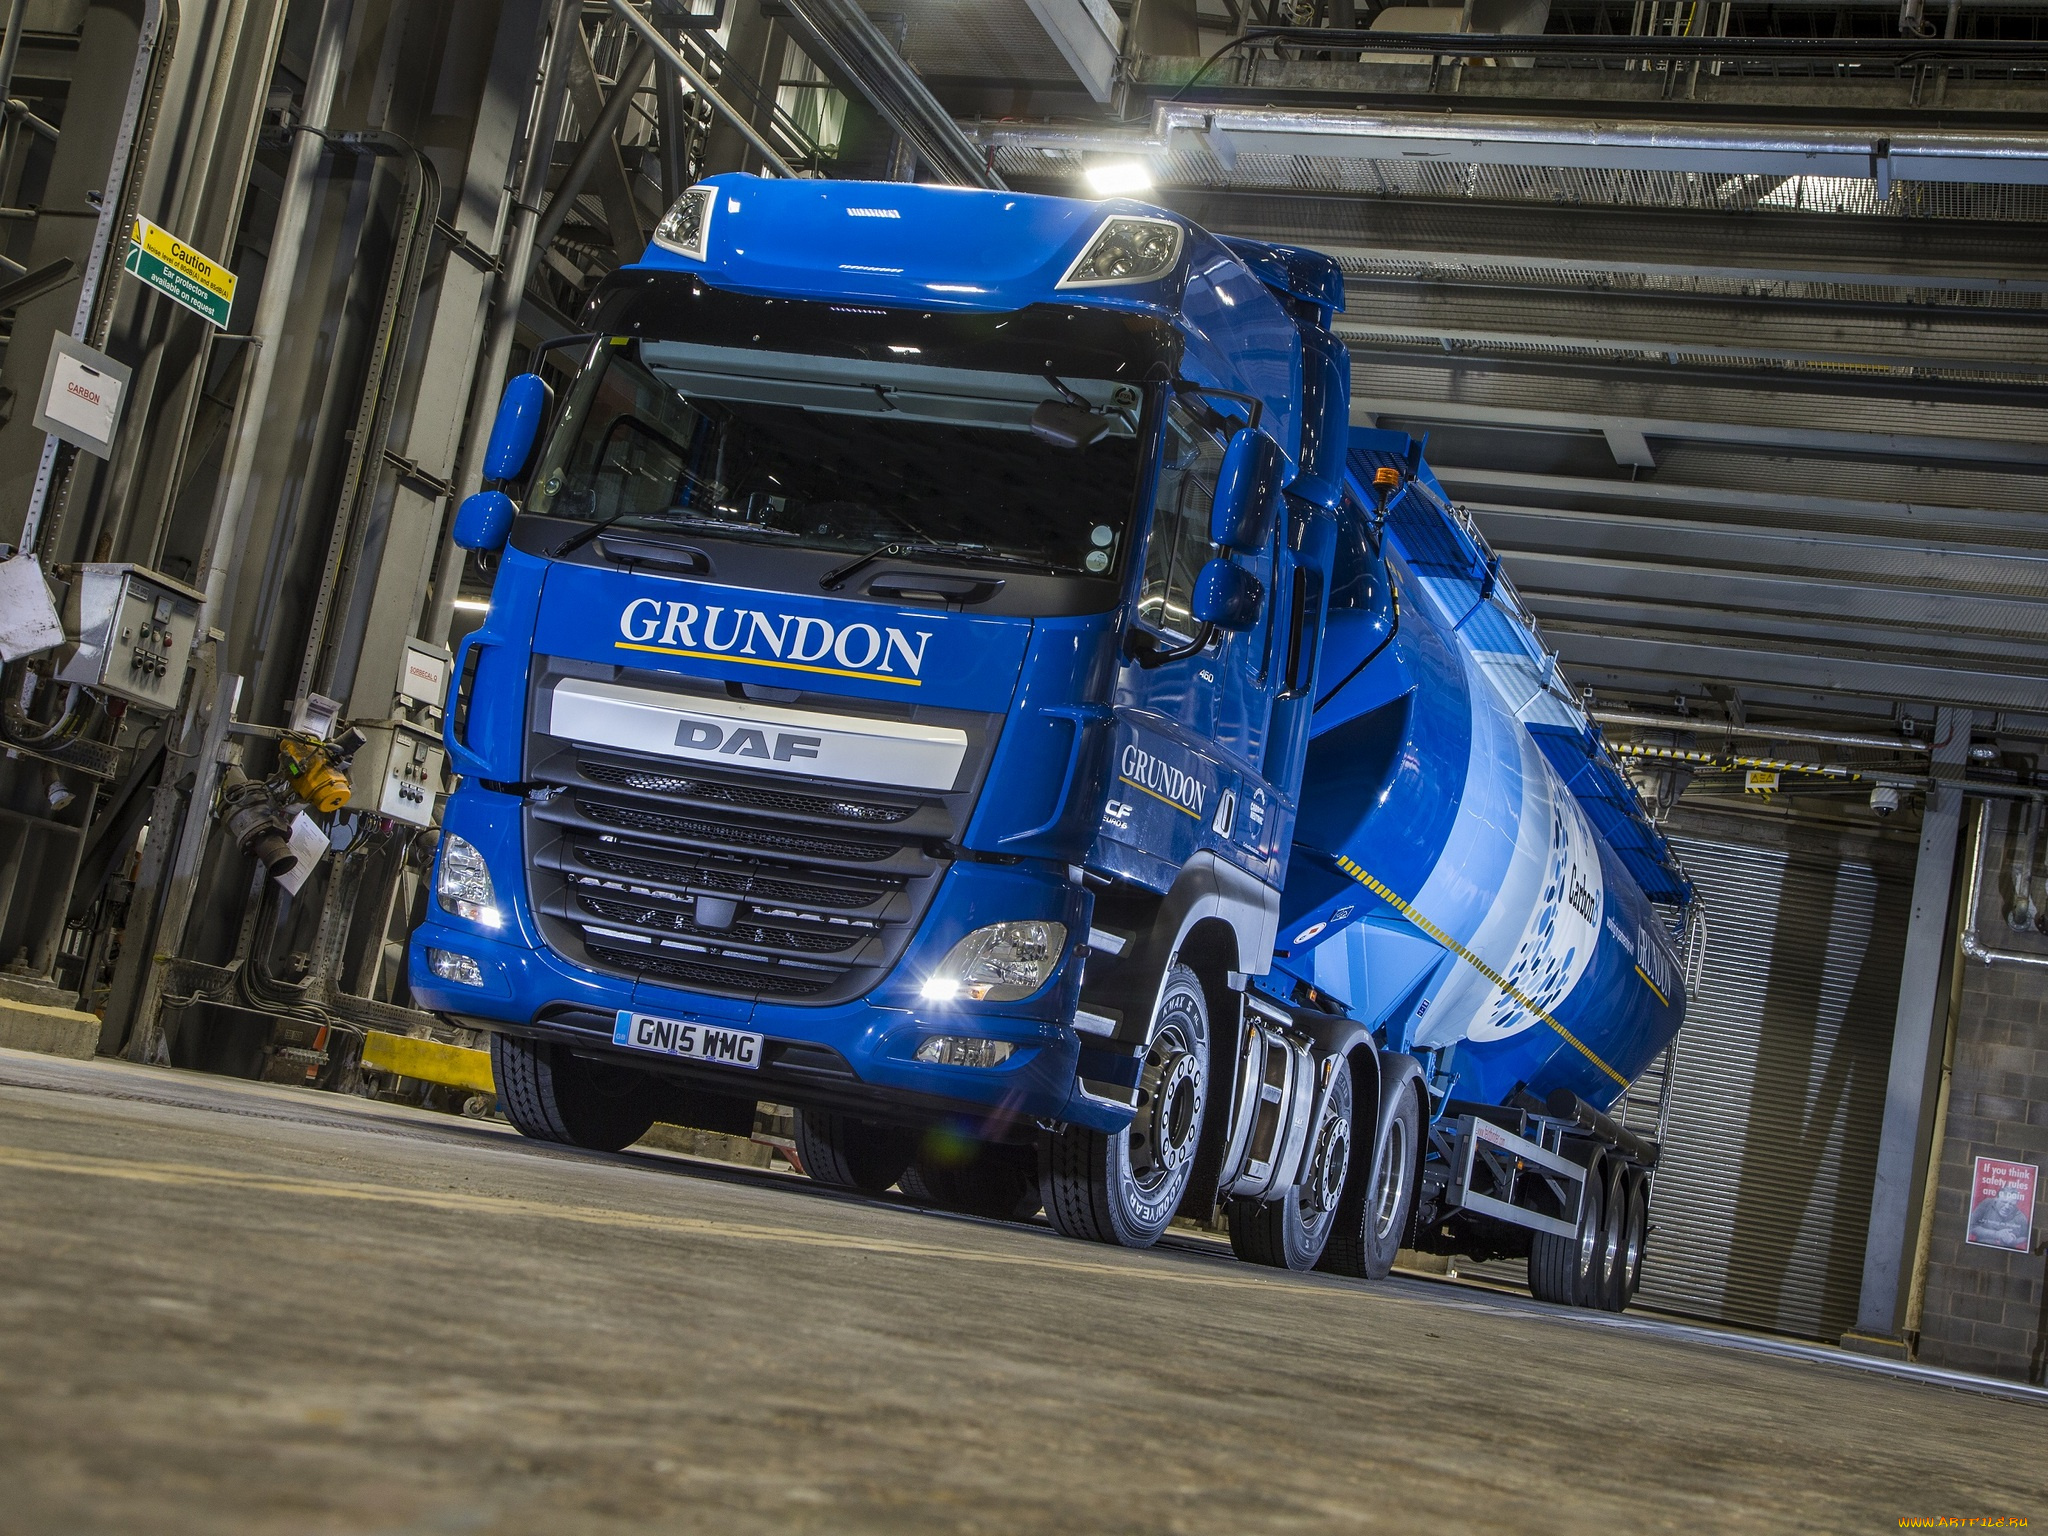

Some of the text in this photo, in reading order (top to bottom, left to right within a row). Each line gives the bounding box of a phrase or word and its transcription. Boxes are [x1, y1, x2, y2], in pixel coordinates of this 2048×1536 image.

[146, 243, 161, 257] Noise
[162, 252, 174, 264] level
[200, 278, 209, 287] and
[171, 243, 211, 277] Caution
[151, 273, 215, 316] available on request
[163, 266, 208, 300] Ear protectors
[68, 382, 100, 403] CARBON
[619, 597, 933, 676] GRUNDON
[1199, 669, 1214, 683] 460
[673, 719, 822, 762] DAF
[1121, 744, 1207, 814] GRUNDON
[1105, 799, 1133, 818] CF
[1637, 923, 1671, 999] GRUNDON
[615, 1033, 626, 1041] GB
[636, 1018, 755, 1063] GN15 WMG
[1982, 1175, 2029, 1190] safety rules
[1983, 1163, 2030, 1179] If you think
[1129, 1174, 1182, 1221] GOODYEAR
[1983, 1188, 1997, 1197] are
[2006, 1190, 2025, 1201] pain
